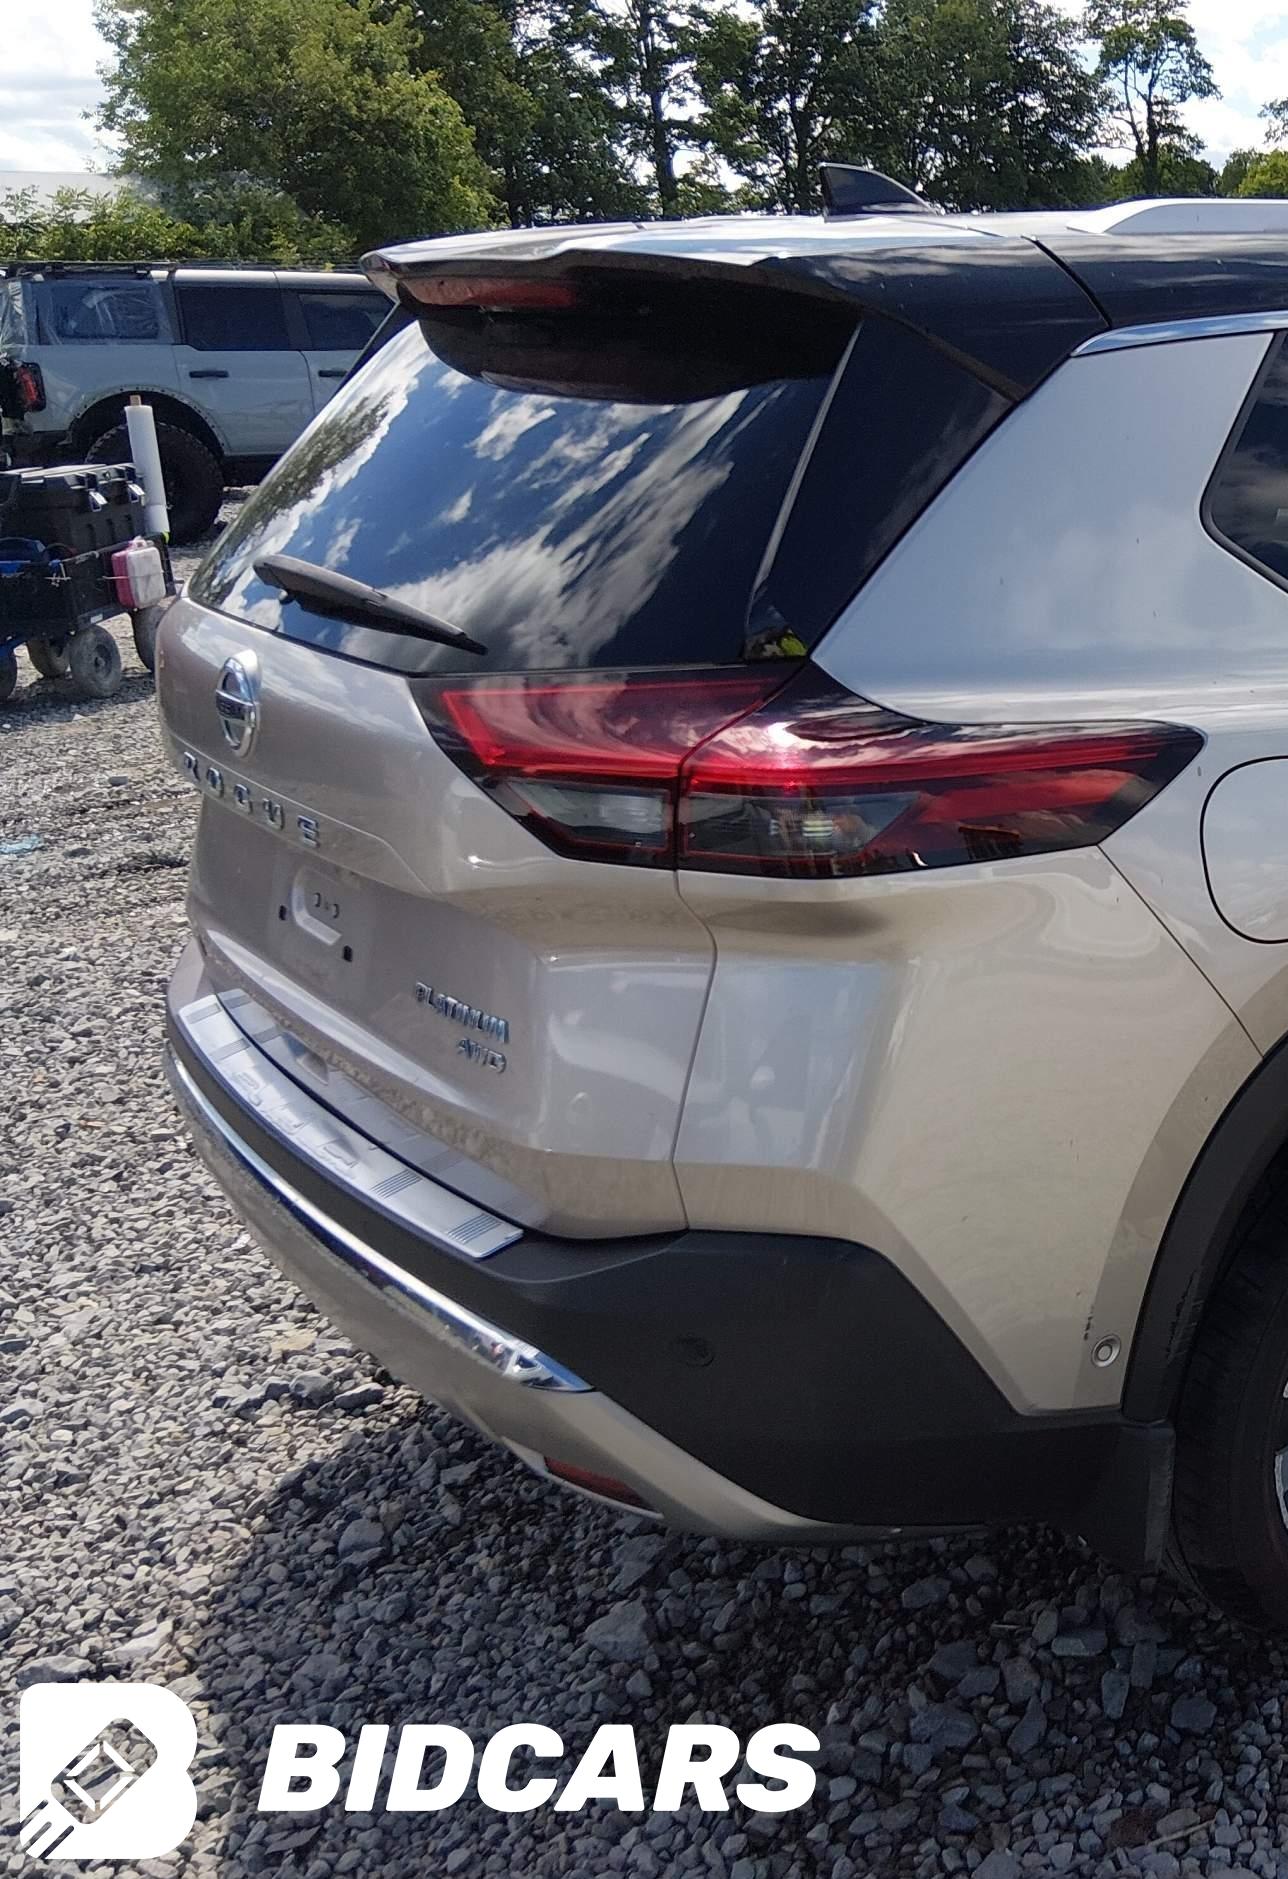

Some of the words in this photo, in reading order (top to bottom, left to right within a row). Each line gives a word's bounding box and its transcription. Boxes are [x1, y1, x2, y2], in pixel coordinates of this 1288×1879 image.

[184, 751, 320, 848] ROGUE
[416, 981, 509, 1043] PLATINUM
[457, 1037, 507, 1073] AWD
